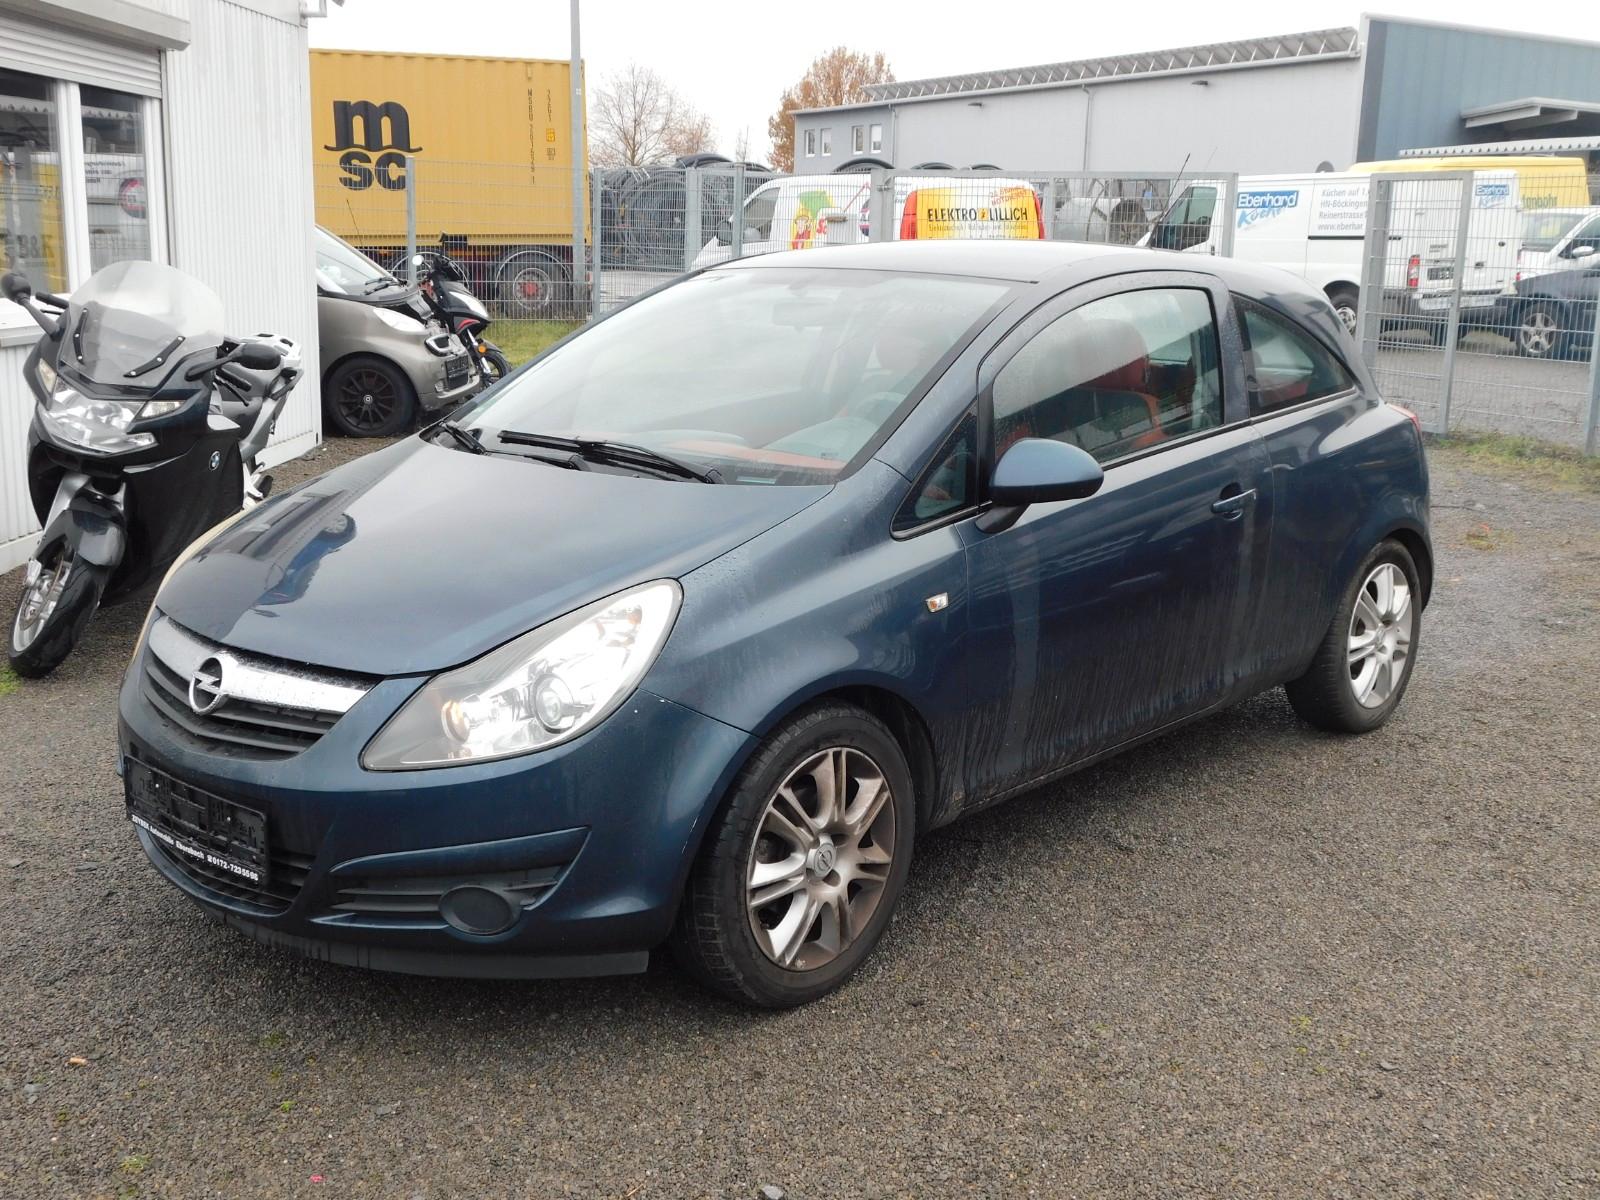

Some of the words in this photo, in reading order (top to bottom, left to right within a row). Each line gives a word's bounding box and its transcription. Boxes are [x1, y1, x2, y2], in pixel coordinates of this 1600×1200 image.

[1348, 187, 1359, 196] auf
[1238, 191, 1298, 208] Eberhard
[928, 208, 977, 221] ELEKTRO
[989, 208, 1028, 221] LILLICH
